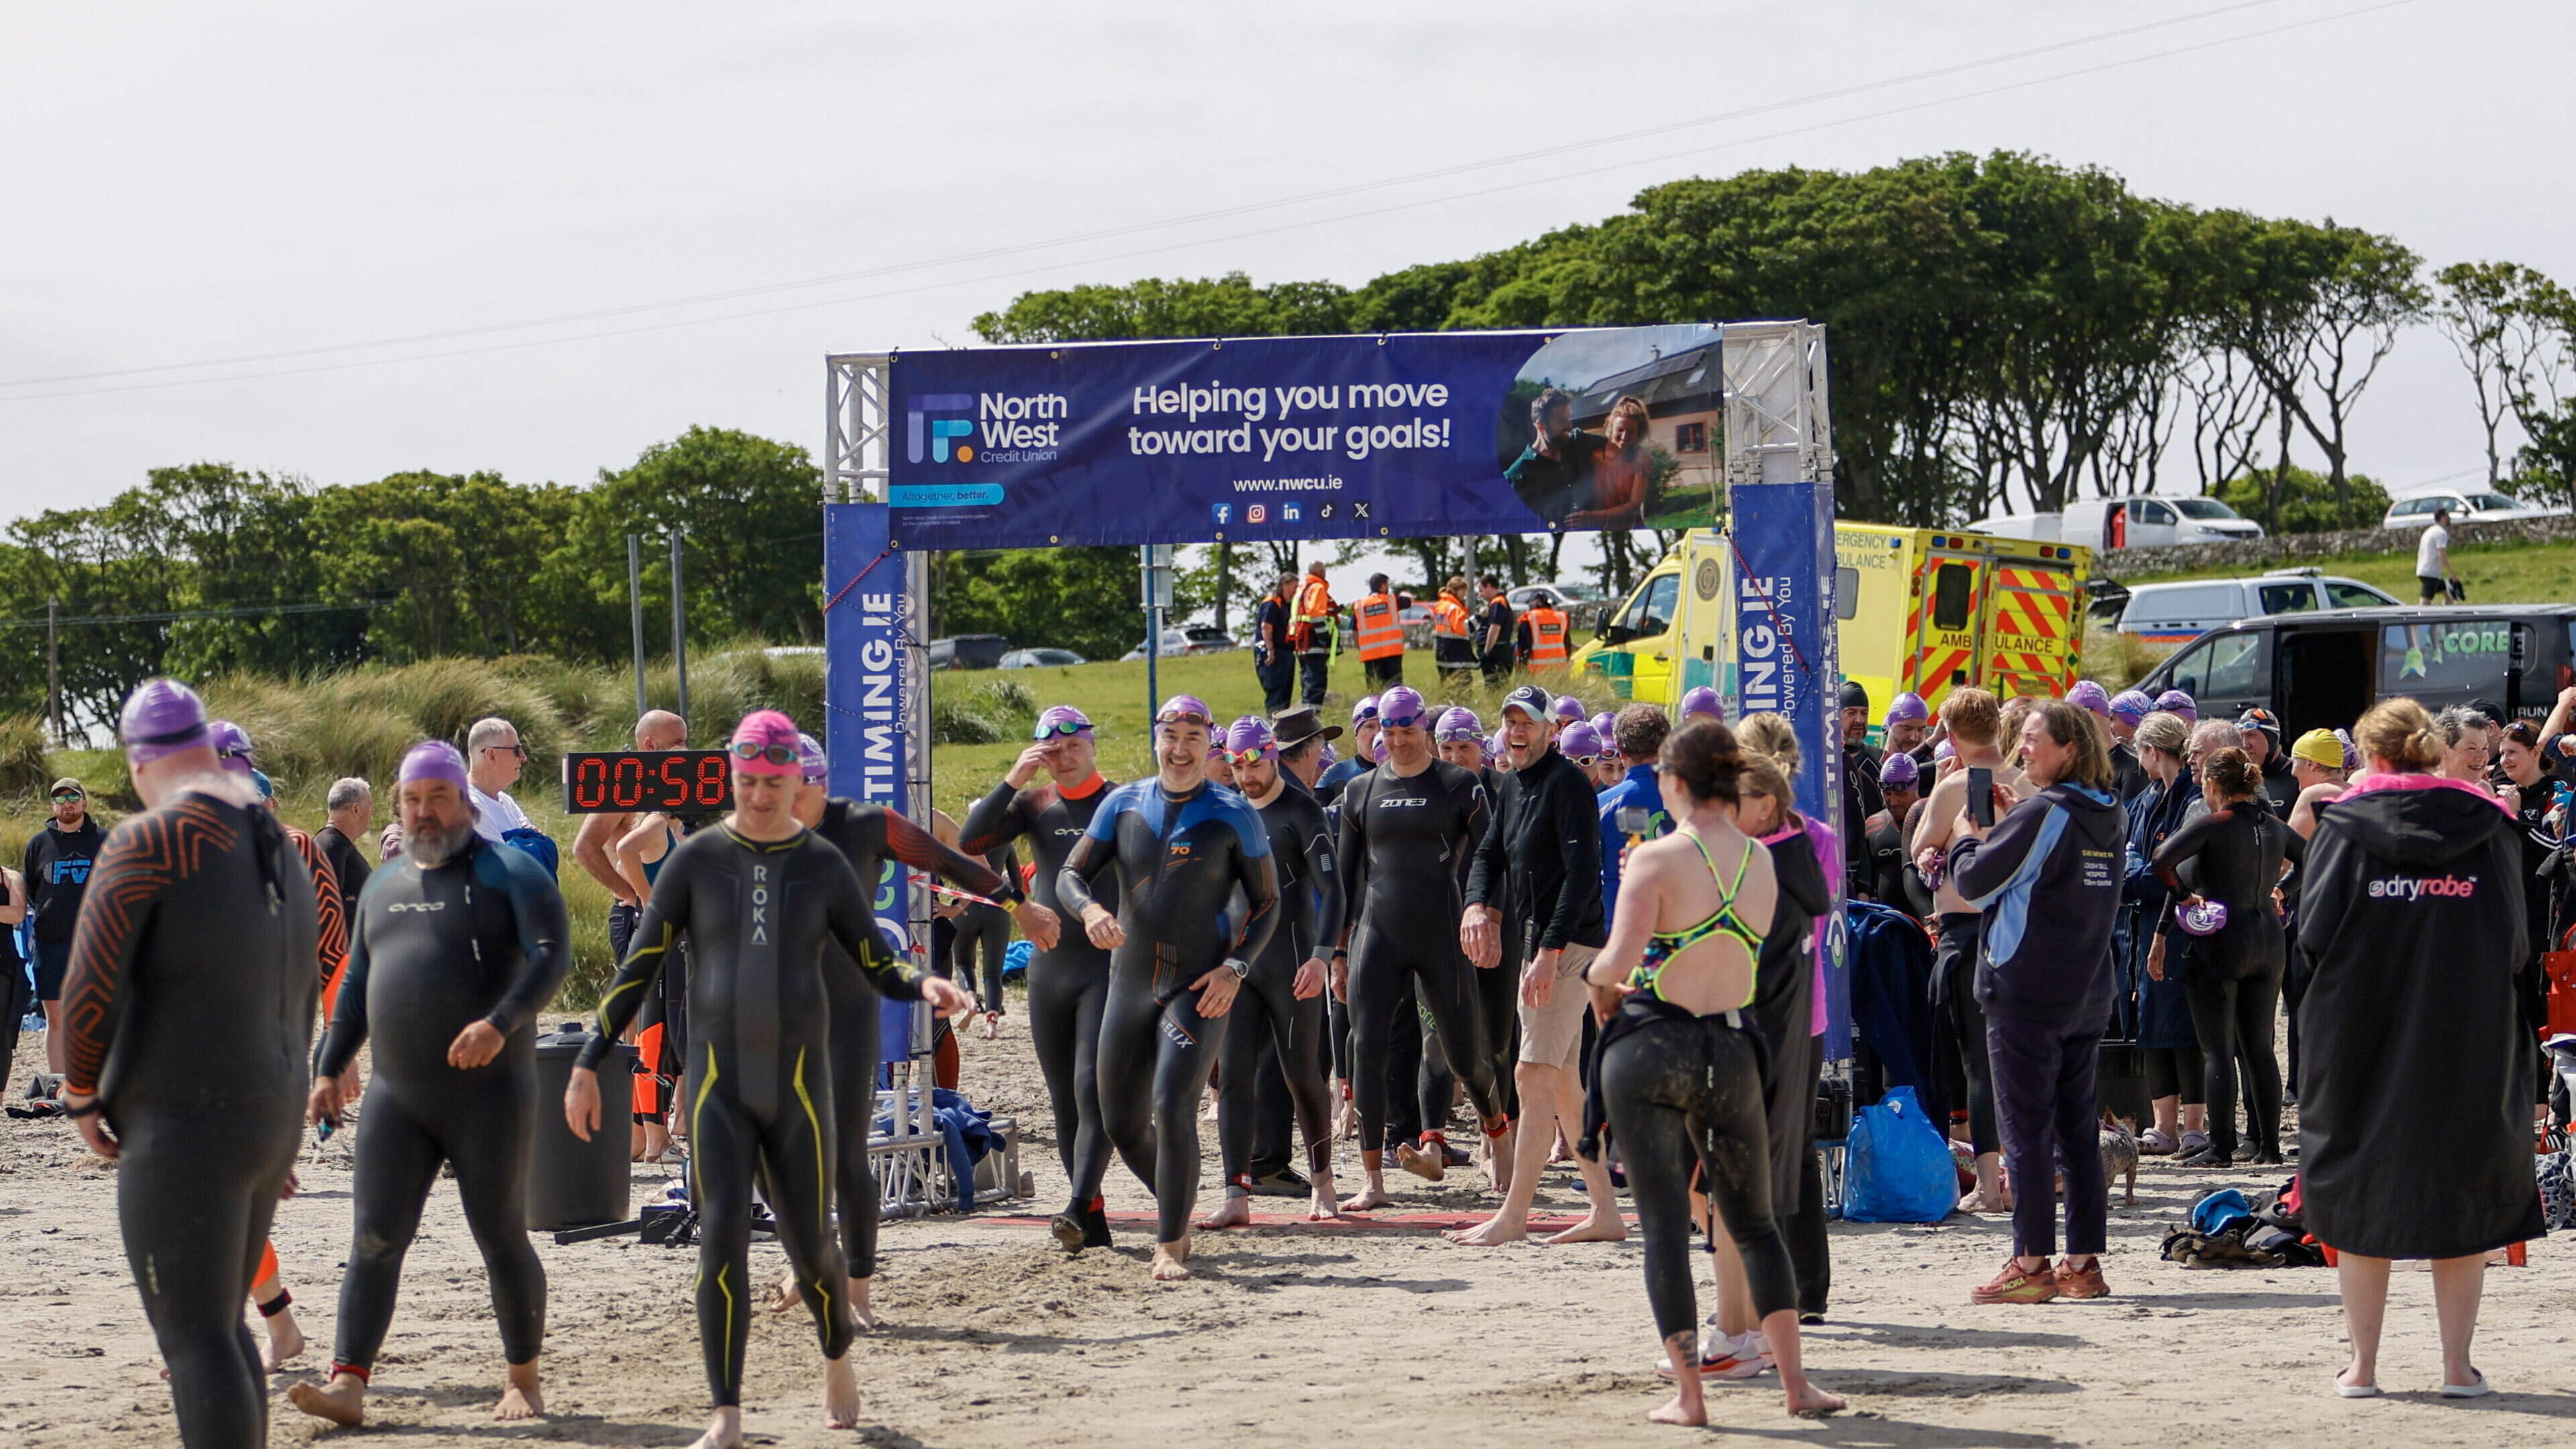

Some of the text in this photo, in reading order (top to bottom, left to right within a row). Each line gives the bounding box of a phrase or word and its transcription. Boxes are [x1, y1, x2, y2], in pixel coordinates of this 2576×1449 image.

[980, 392, 1067, 420] North
[1133, 380, 1449, 423] Helping you move
[980, 421, 1060, 449] West
[1128, 417, 1451, 462] toward your goals!
[981, 449, 1057, 463] Credit Union
[1233, 474, 1344, 492] www.nwcu.ie
[902, 490, 988, 503] Altogether, better.
[1836, 533, 1886, 549] ERGENCY
[1836, 553, 1886, 569] BULANCE
[1776, 576, 1792, 608] You
[894, 594, 905, 624] You
[2444, 631, 2509, 654] CORE
[1778, 643, 1796, 720] Powered
[2518, 706, 2548, 717] RUN
[1054, 828, 1085, 836] orc
[1171, 847, 1191, 855] 70
[388, 902, 445, 912] orca
[1160, 1018, 1193, 1049] HELIX
[2002, 1277, 2026, 1292] HOKA
